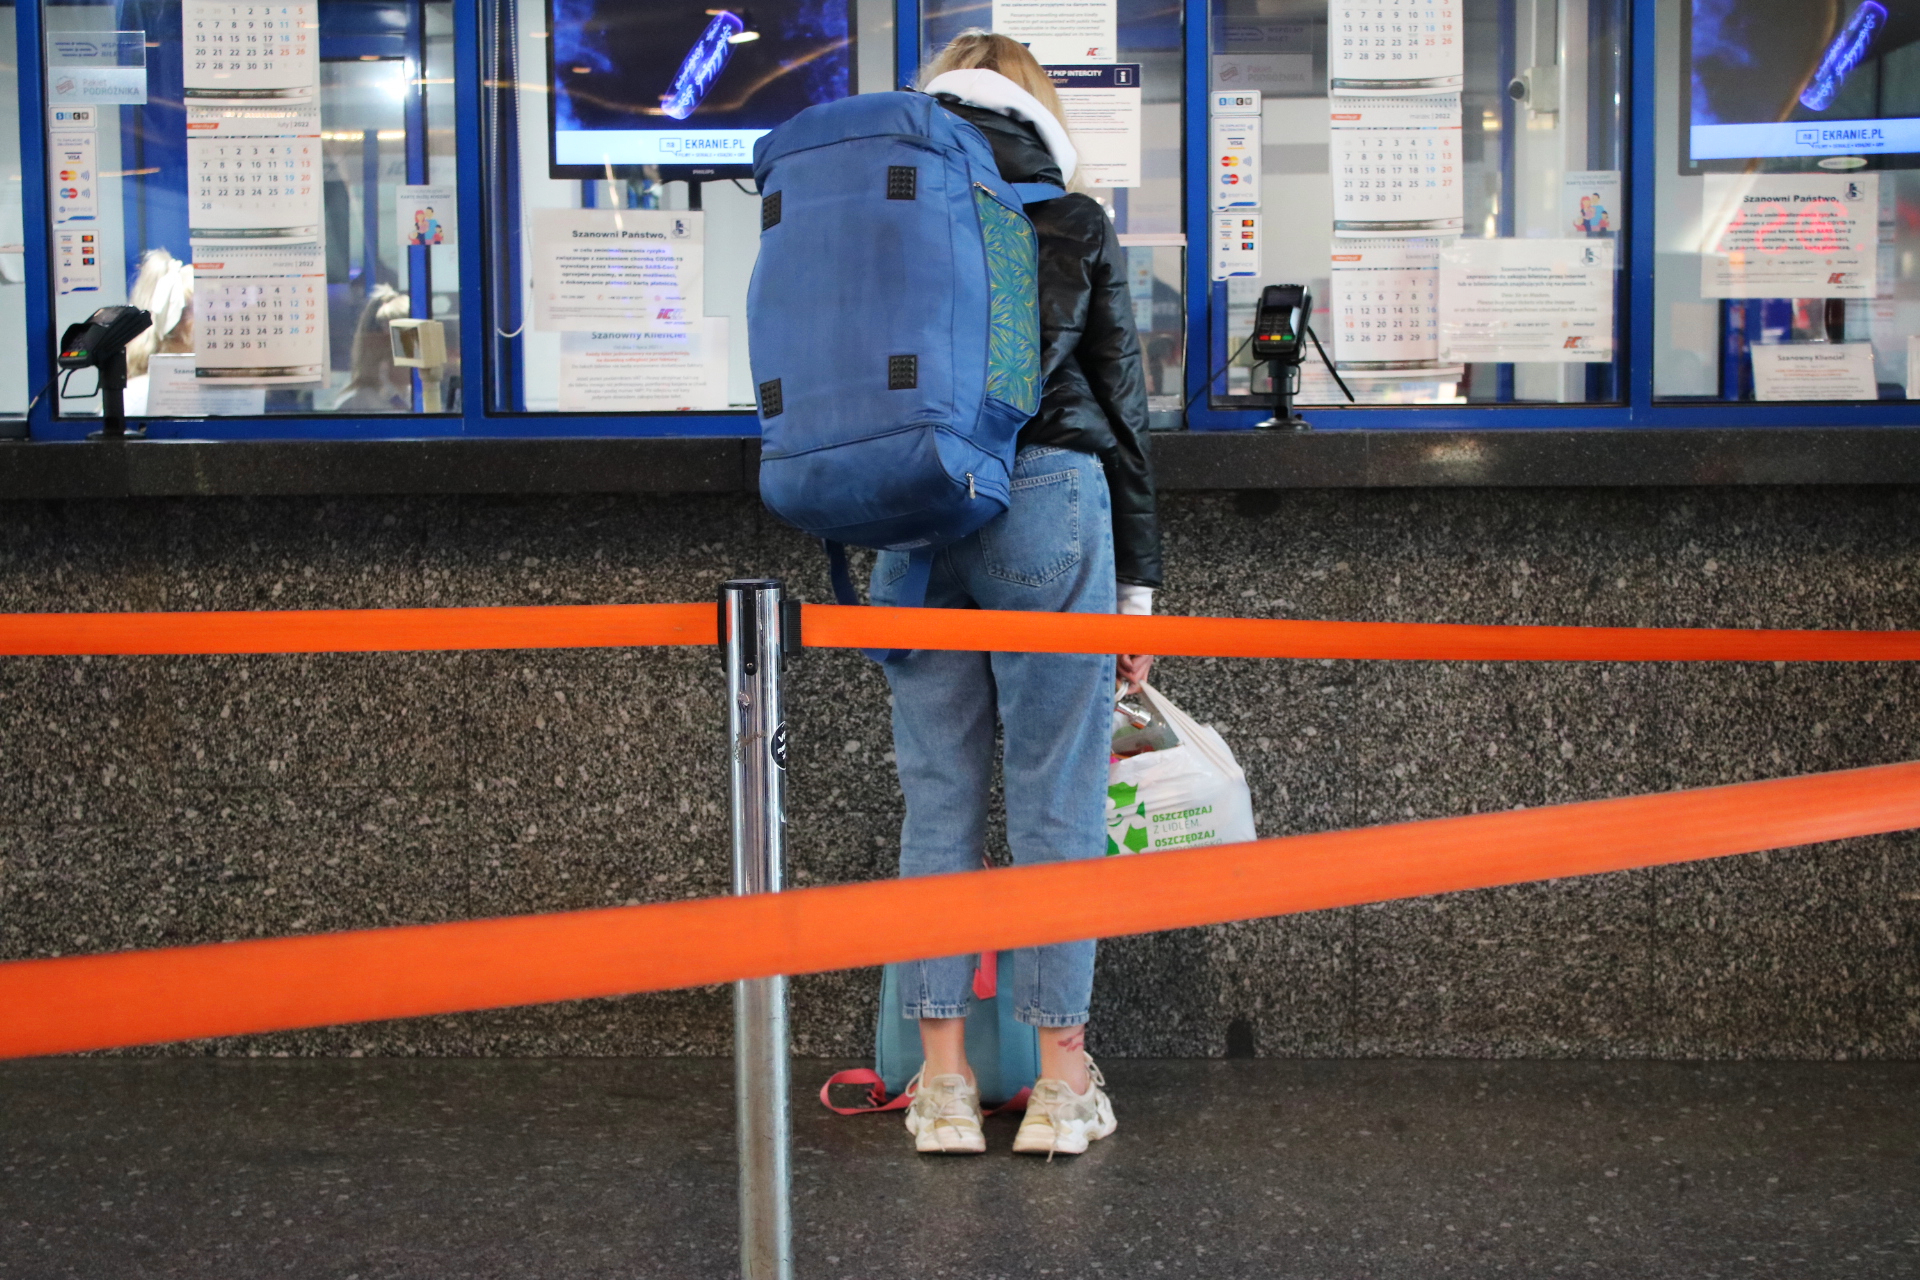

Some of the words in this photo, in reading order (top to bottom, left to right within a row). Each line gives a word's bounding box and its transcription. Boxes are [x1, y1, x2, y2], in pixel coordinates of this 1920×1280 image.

[1822, 129, 1884, 140] EKRANIE.PL
[685, 139, 745, 149] EKRANIE.PL
[1794, 195, 1839, 203] Państwo,
[572, 230, 619, 239] Szanowni
[622, 230, 667, 240] Państwo,
[1152, 805, 1213, 823] OSZCZĘDZAJ
[1153, 825, 1159, 834] Z
[1155, 830, 1215, 848] OSZCZĘDZAJ
